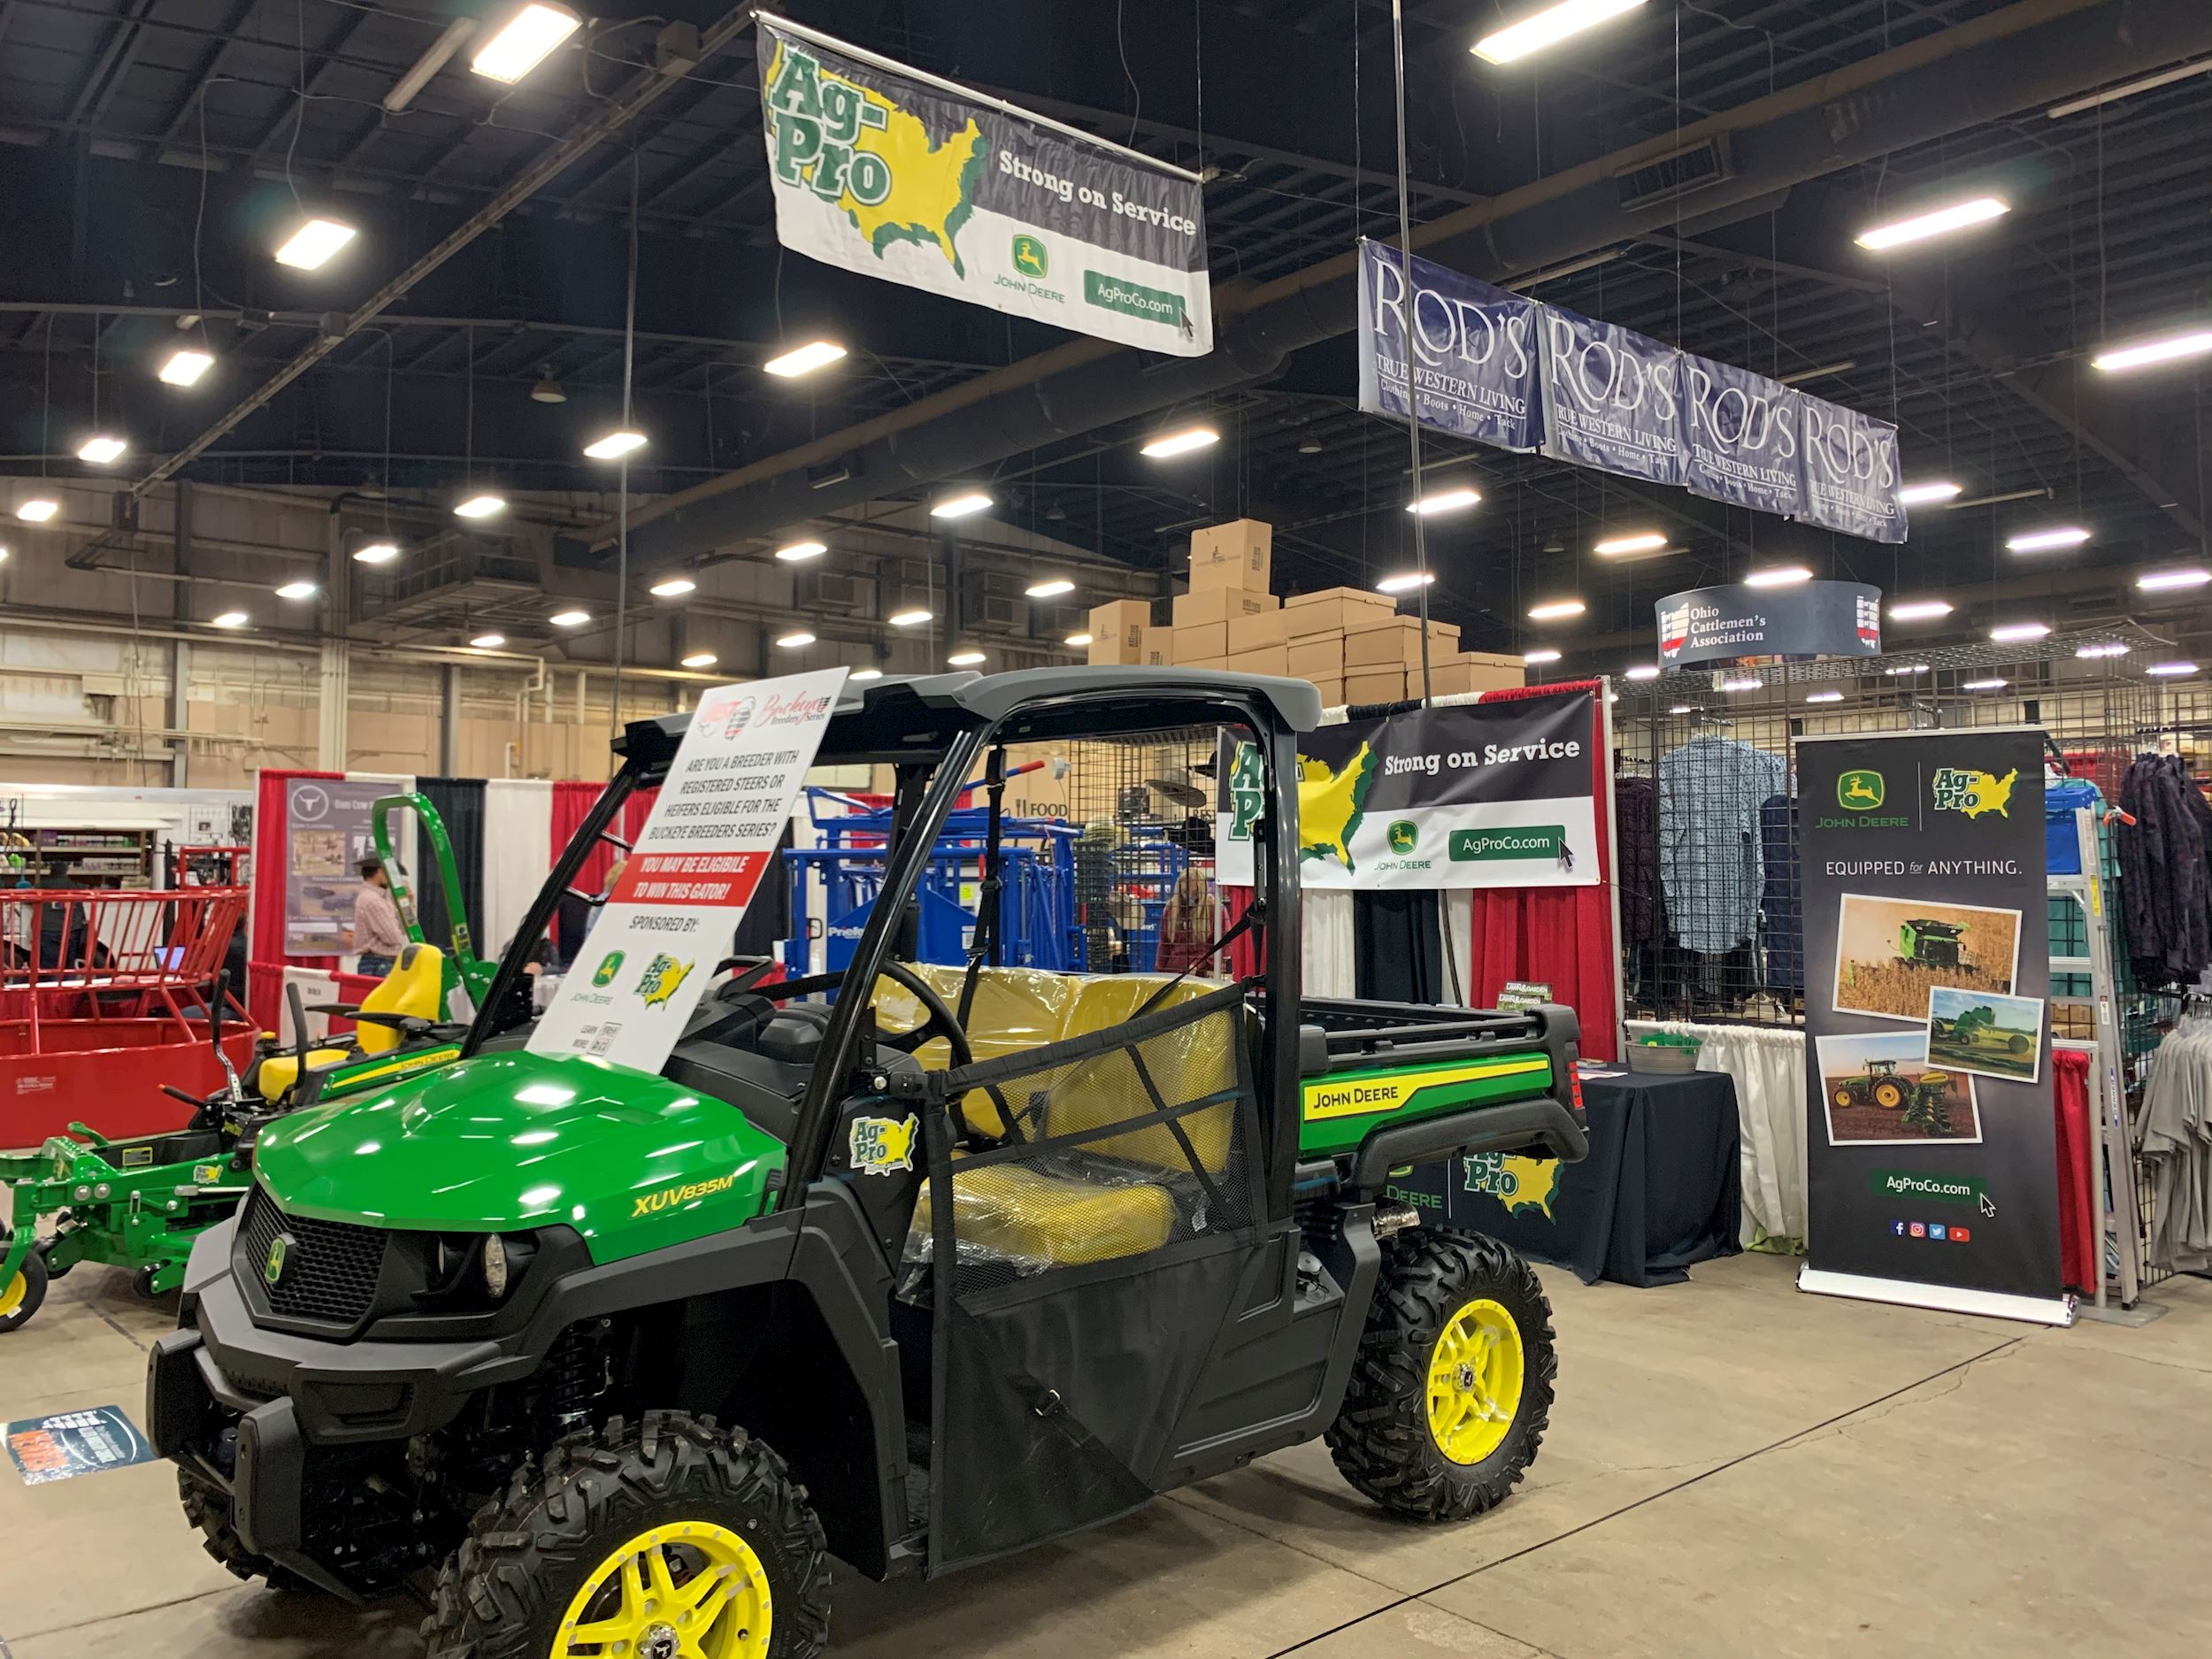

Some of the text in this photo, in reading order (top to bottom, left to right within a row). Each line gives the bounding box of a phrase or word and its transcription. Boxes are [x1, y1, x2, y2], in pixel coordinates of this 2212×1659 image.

[770, 46, 887, 142] Ag-
[773, 113, 892, 205] Pro
[999, 150, 1196, 236] Strong on Service
[994, 273, 1065, 303] JOHN DEERE
[1098, 284, 1173, 315] AgProCo.com
[1372, 256, 1528, 380] ROD'S
[1547, 315, 1676, 421] ROD'S
[1376, 353, 1526, 414] TRUE WESTERN LIVING
[1424, 394, 1449, 411] Boots
[1460, 404, 1484, 422] Home
[1494, 414, 1516, 430] Tack
[1687, 365, 1796, 458] ROD'S
[1578, 412, 1632, 442] WESTERN
[1635, 430, 1677, 452] LIVING
[1590, 437, 1609, 453] Boots
[1618, 446, 1640, 460] Home
[1648, 454, 1669, 467] Tack
[1806, 405, 1893, 488] ROD'S
[1715, 453, 1758, 480] WESTERN
[1760, 468, 1796, 487] LIVING
[1690, 606, 1719, 620] Ohio
[1691, 614, 1766, 634] Cattlemen's
[1691, 631, 1763, 649] Association
[686, 750, 799, 772] ARE YOU A BREEDER WITH
[1385, 737, 1581, 777] Strong on Service
[680, 774, 785, 795] REGISTERED STEERS OR
[1935, 768, 1979, 790] Ag-
[664, 798, 782, 818] HEIFERS ELIGIBLE FOR THE
[1030, 803, 1068, 817] FOOD
[1934, 789, 1980, 810] Pro
[649, 822, 777, 840] BUCKEYE BREEDERS SERIES?
[1815, 817, 1909, 828] JOHN DEERE
[1462, 836, 1550, 854] AgProCo.com
[641, 856, 660, 872] YOU
[659, 856, 683, 872] MAY
[681, 856, 699, 873] BE
[1374, 859, 1432, 871] JOHN DEERE
[1825, 860, 2023, 876] EQUIPPED for ANYTHING.
[633, 882, 732, 900] TO WIN THIS GATOR!
[630, 916, 700, 933] SPONSORED BY:
[634, 973, 662, 996] Pro
[1313, 1086, 1398, 1109] JOHN DEERE
[854, 1121, 886, 1144] Ag-
[855, 1141, 887, 1163] Pro
[1464, 1160, 1518, 1195] Pro
[1886, 1175, 1971, 1197] AgProCo.com
[631, 1174, 735, 1218] XUV835M
[1386, 1185, 1442, 1209] DEERE
